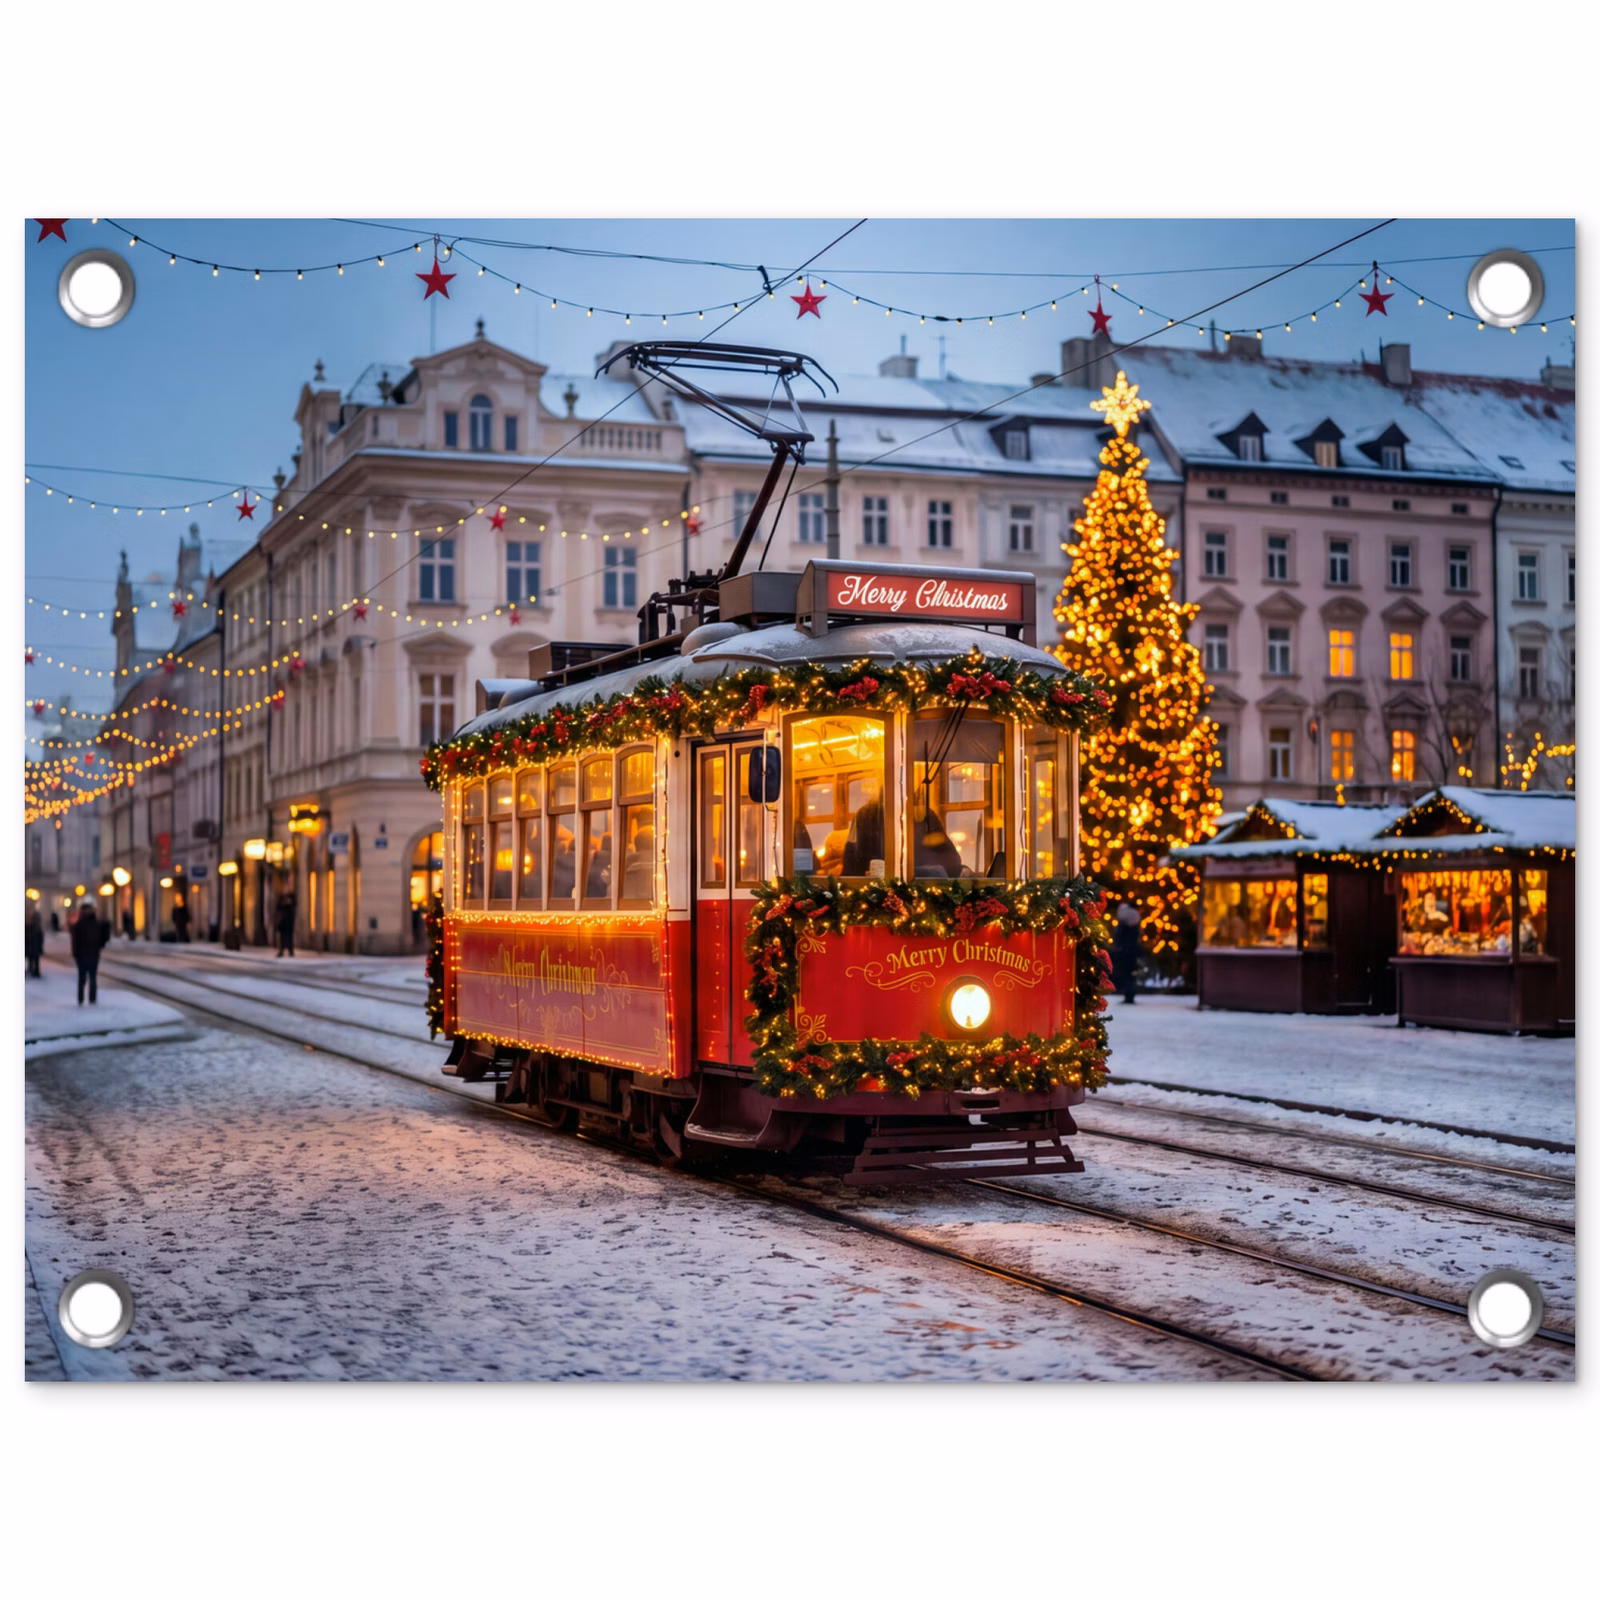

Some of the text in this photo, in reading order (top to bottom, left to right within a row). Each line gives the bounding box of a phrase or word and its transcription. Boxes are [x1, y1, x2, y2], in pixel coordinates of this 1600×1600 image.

[838, 576, 1008, 612] Merry Christmas
[886, 939, 1031, 974] Merry Christmas
